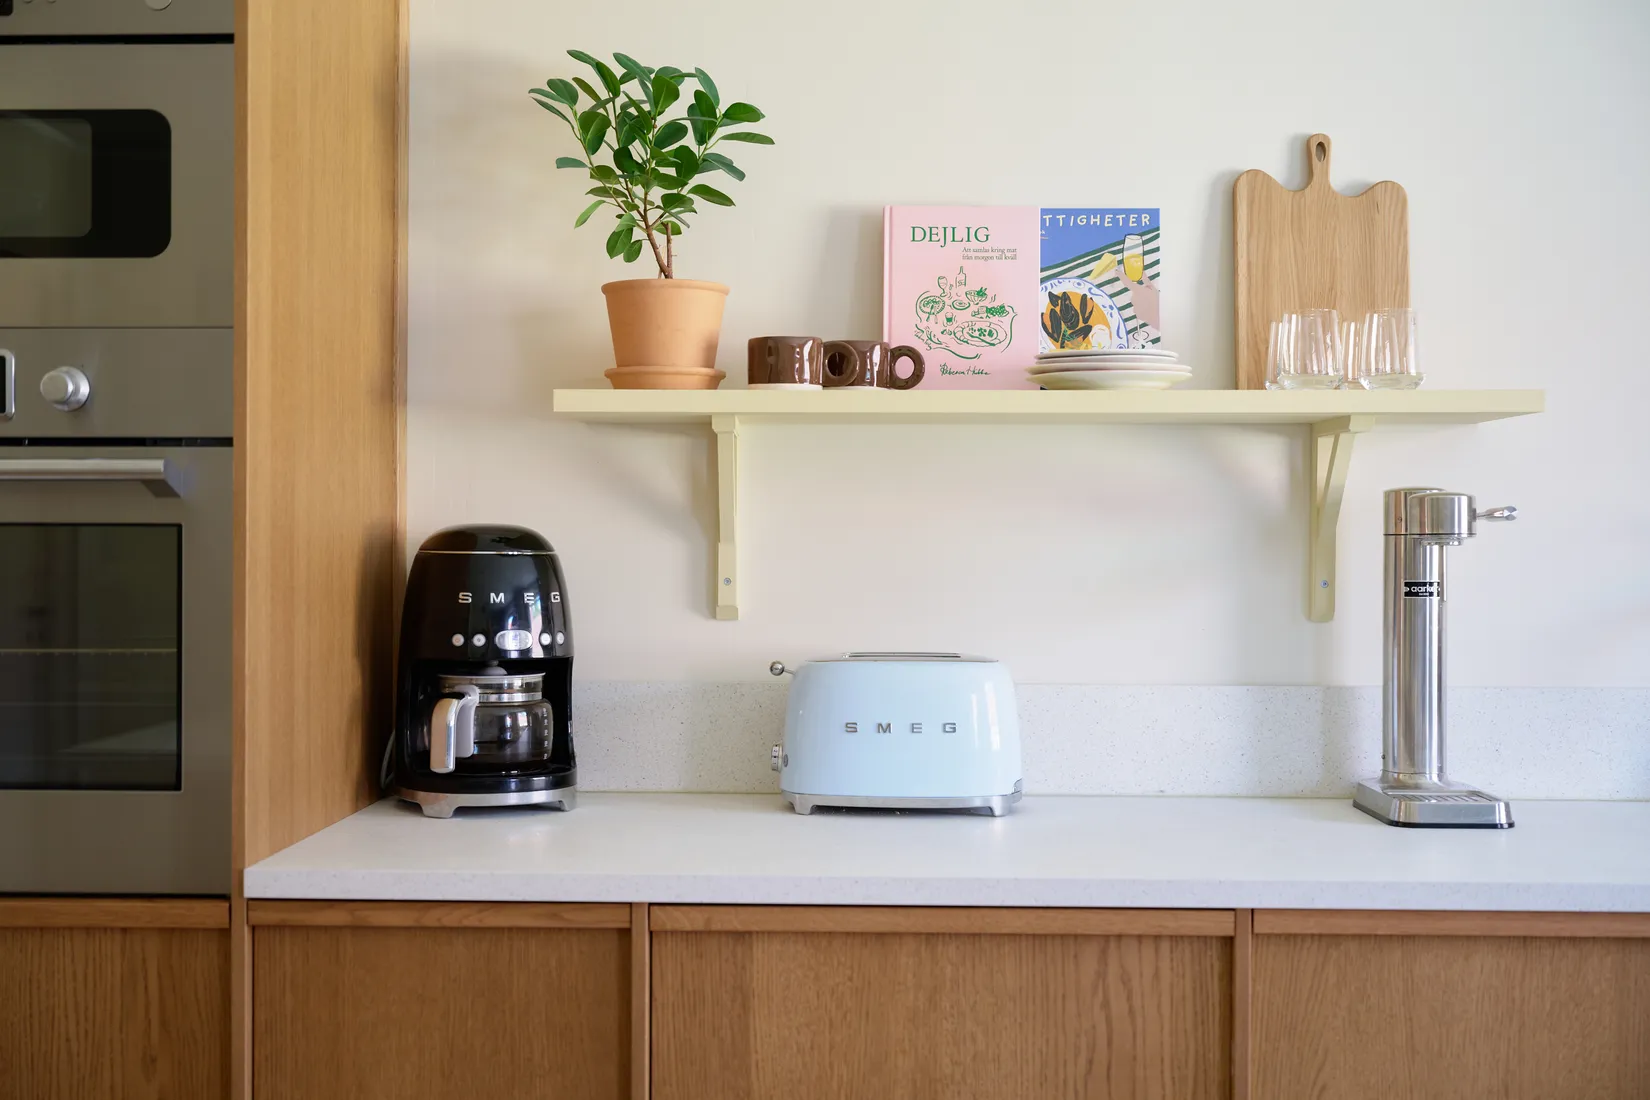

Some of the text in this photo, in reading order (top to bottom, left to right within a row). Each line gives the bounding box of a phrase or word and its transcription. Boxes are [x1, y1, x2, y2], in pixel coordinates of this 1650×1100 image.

[1043, 213, 1151, 227] TTIGHETER
[911, 226, 991, 248] DEJLIG
[991, 246, 1006, 255] kring
[458, 592, 561, 604] SMEG
[845, 722, 957, 734] SMEG
